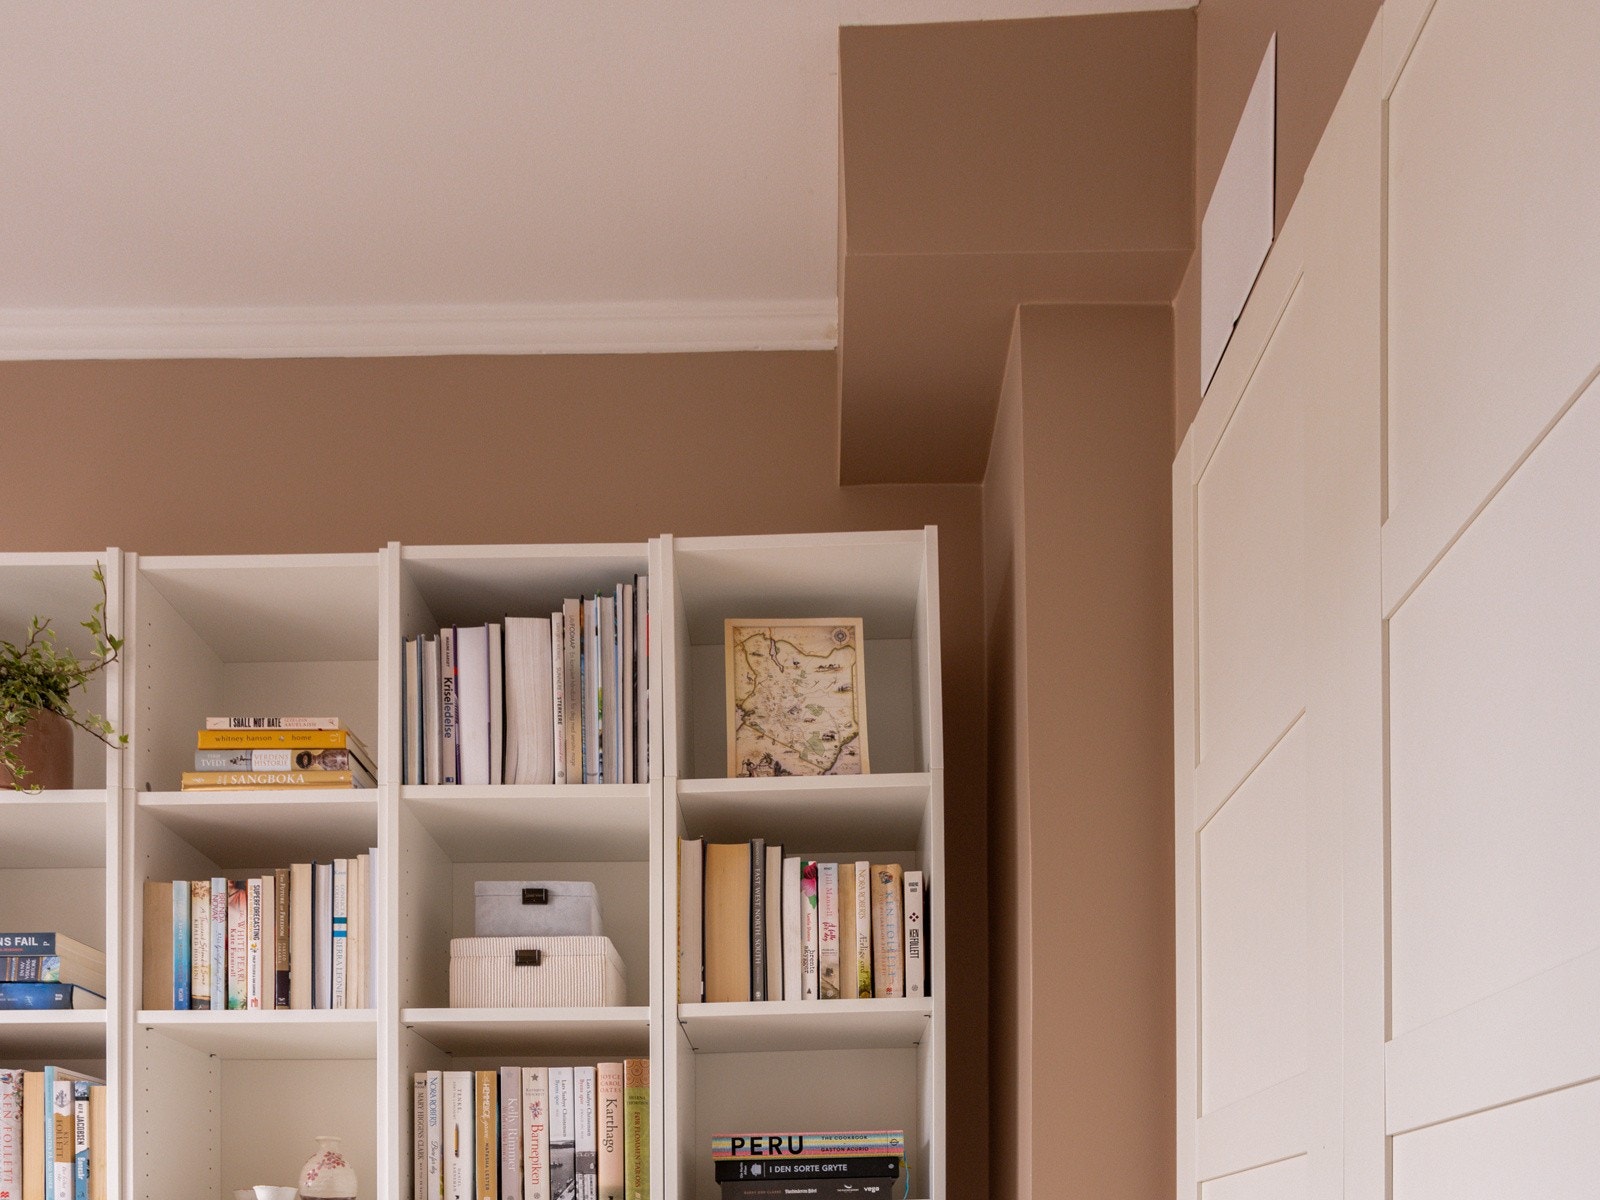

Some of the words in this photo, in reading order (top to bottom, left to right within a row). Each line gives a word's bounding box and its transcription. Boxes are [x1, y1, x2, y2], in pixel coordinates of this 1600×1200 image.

[443, 678, 454, 738] Kriseledelse
[233, 717, 250, 728] SHALL
[253, 717, 266, 728] NOT
[267, 717, 282, 728] HATE
[215, 734, 244, 742] whitney
[246, 733, 272, 741] hanson
[200, 759, 226, 767] TVEDT
[230, 774, 304, 784] SANGBOKA
[858, 869, 867, 891] NORA
[858, 892, 867, 920] ROBERTS
[886, 892, 894, 916] KEN
[15, 937, 38, 946] FAIL
[237, 920, 245, 953] WHITE
[858, 932, 867, 958] Ærlige
[910, 938, 919, 959] FOLLETT
[886, 923, 896, 977] FOLLETT
[237, 956, 245, 984] PEARL
[430, 1077, 438, 1099] NORA
[3, 1093, 13, 1119] KEN
[430, 1099, 438, 1127] ROBERTS
[506, 1098, 518, 1123] Kelly
[76, 1114, 84, 1146] JACOBSEN
[603, 1099, 618, 1153] Karthago
[3, 1127, 13, 1184] FOLLETT
[508, 1128, 518, 1172] Rimmer
[529, 1124, 544, 1185] Barnepiken
[731, 1136, 804, 1156] PERU
[822, 1164, 848, 1172] GRYTE
